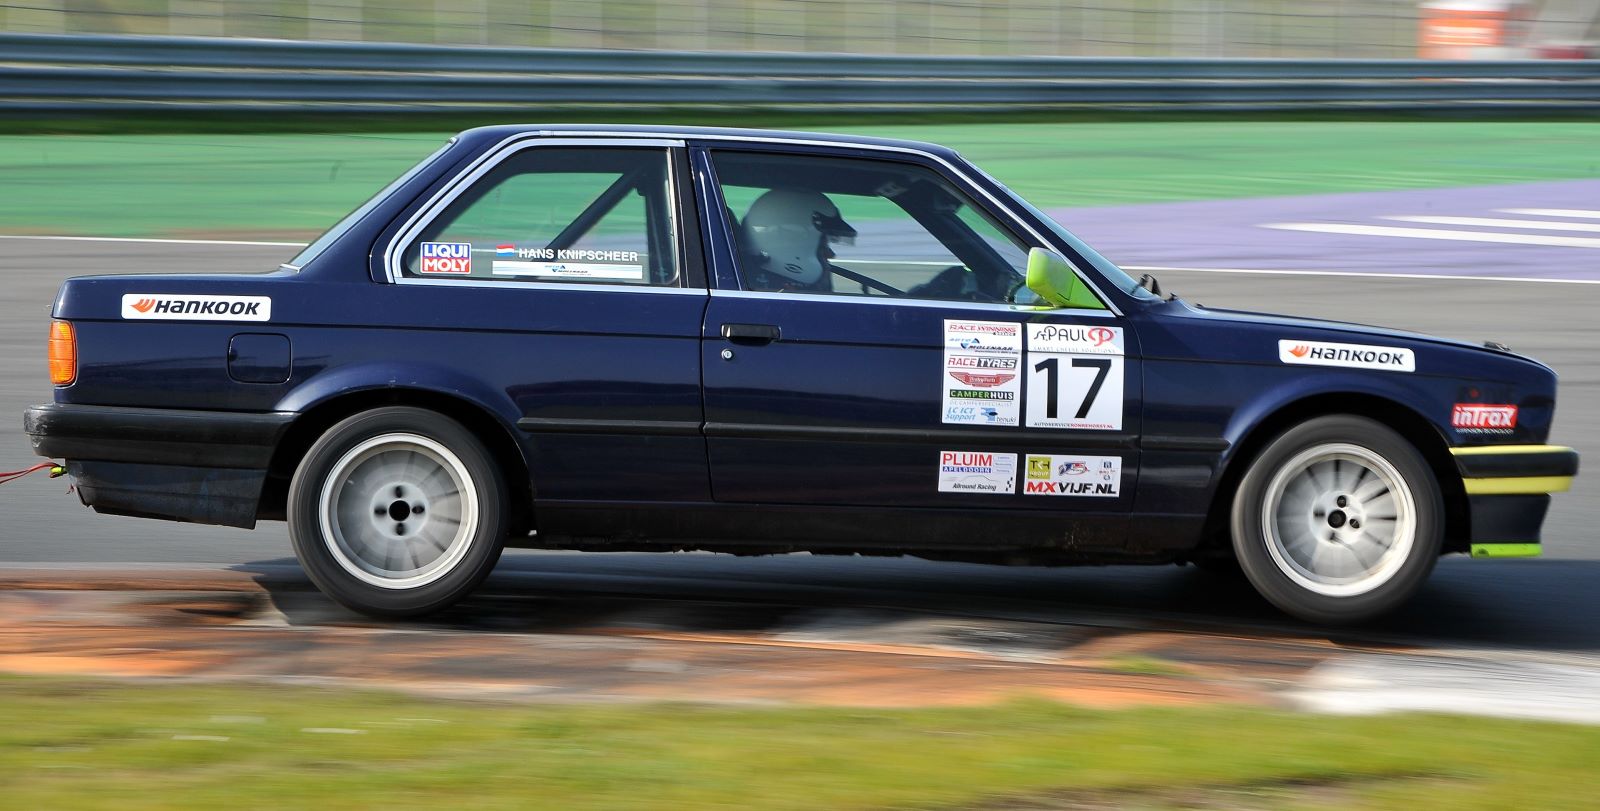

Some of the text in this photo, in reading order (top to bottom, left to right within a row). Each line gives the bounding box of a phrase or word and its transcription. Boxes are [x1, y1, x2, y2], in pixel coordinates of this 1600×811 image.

[424, 244, 468, 258] LIQUI
[518, 249, 639, 262] HANS KNIPSCHEER
[424, 258, 469, 272] MOLY
[977, 325, 1017, 333] WINNING
[1044, 325, 1088, 342] PAUL
[948, 358, 1016, 369] RACE TYRES
[1034, 357, 1112, 419] 17
[950, 390, 1014, 400] CAMPERHUIS
[943, 453, 992, 467] PLUIM
[943, 466, 991, 474] APELDOORN
[952, 482, 997, 492] Allround Racing
